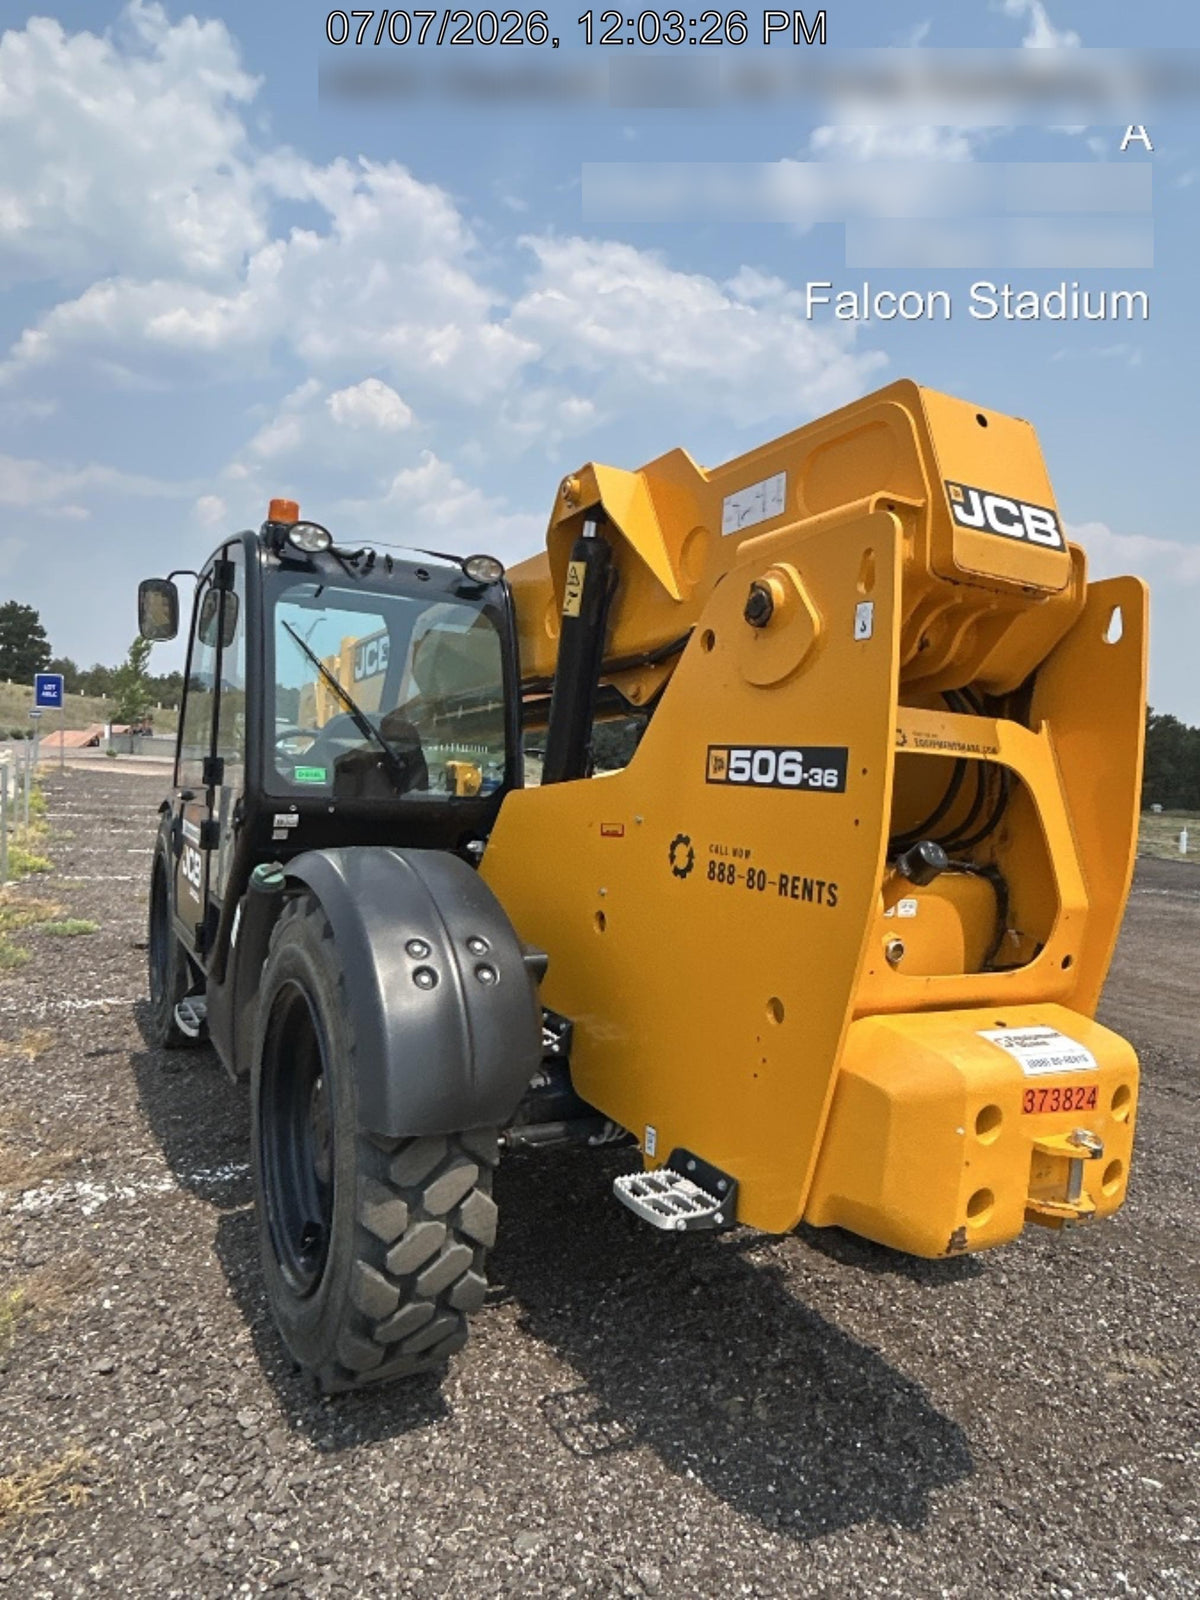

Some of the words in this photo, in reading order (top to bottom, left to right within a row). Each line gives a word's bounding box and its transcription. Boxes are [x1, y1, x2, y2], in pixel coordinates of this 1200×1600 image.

[953, 490, 1061, 547] JCB
[182, 843, 201, 888] JCB
[708, 843, 729, 856] CALL
[707, 859, 839, 908] 888-80-RENTS
[1023, 1087, 1097, 1114] 373824
